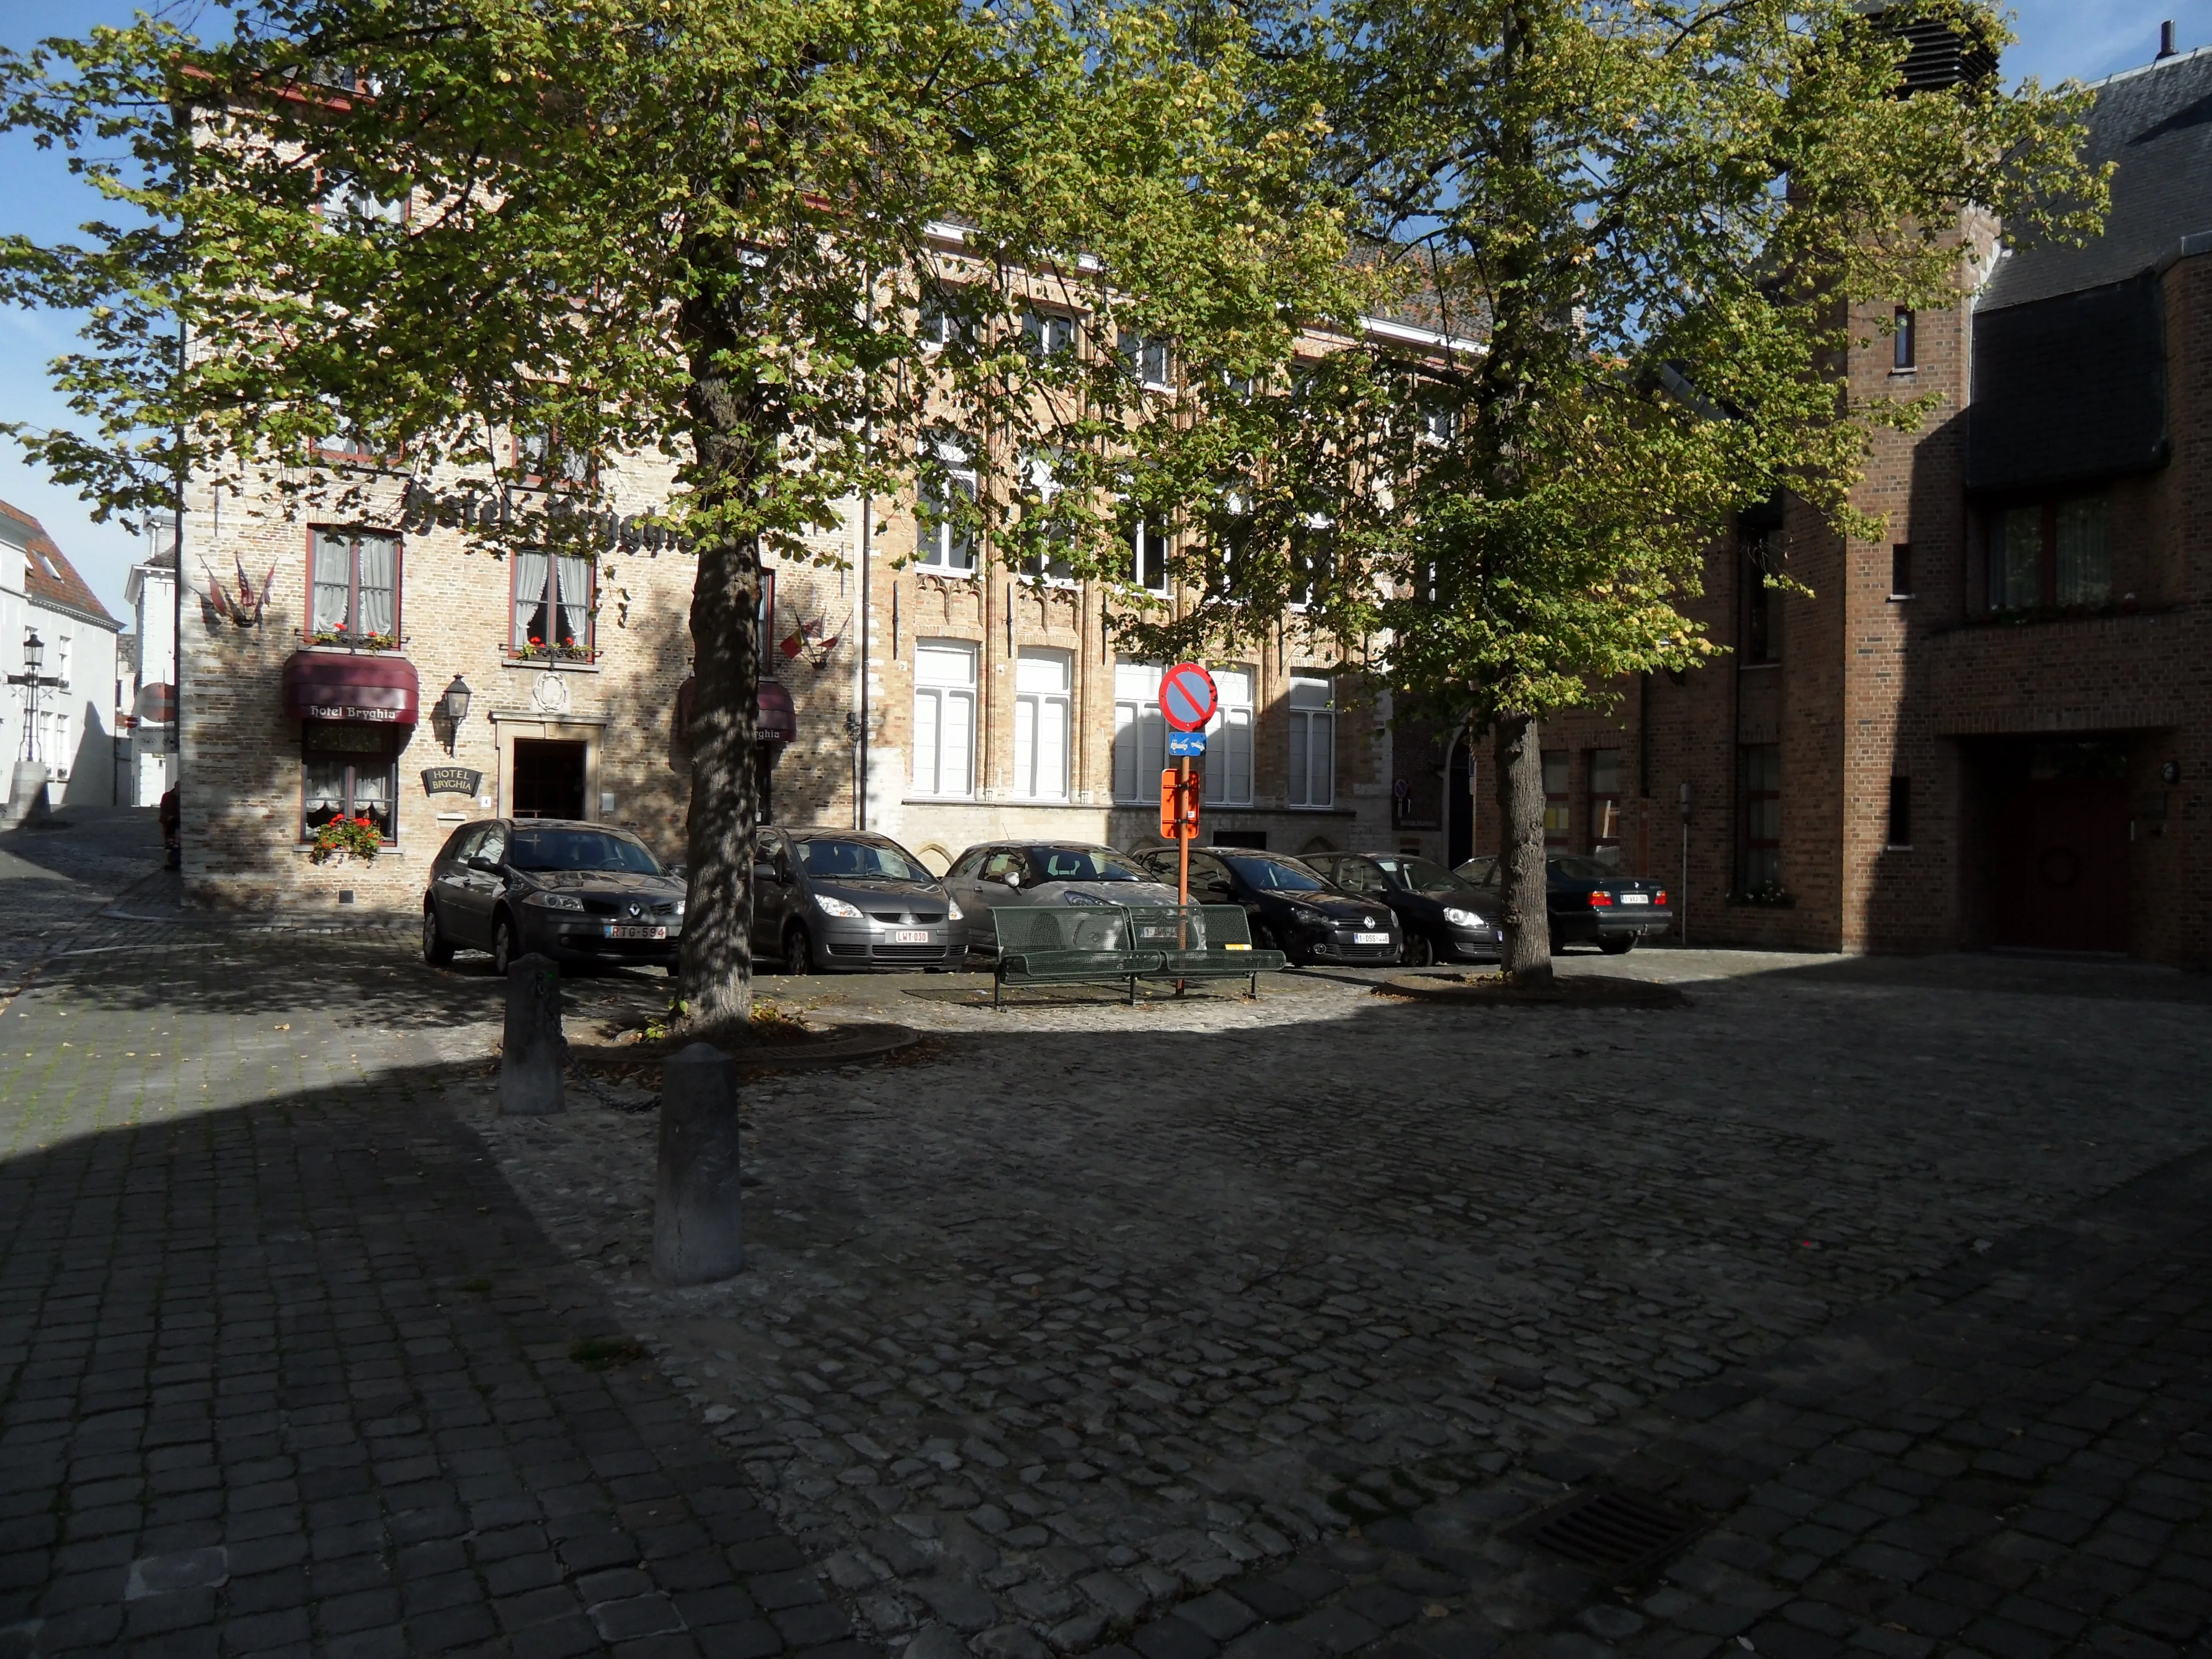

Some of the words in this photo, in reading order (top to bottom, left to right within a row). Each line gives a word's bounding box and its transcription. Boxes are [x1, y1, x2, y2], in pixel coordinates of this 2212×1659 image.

[347, 707, 397, 720] Bryghia
[756, 729, 780, 739] ghia
[433, 770, 470, 780] HOTEL
[432, 779, 471, 790] BRYGHIA
[612, 927, 665, 937] RTG-594
